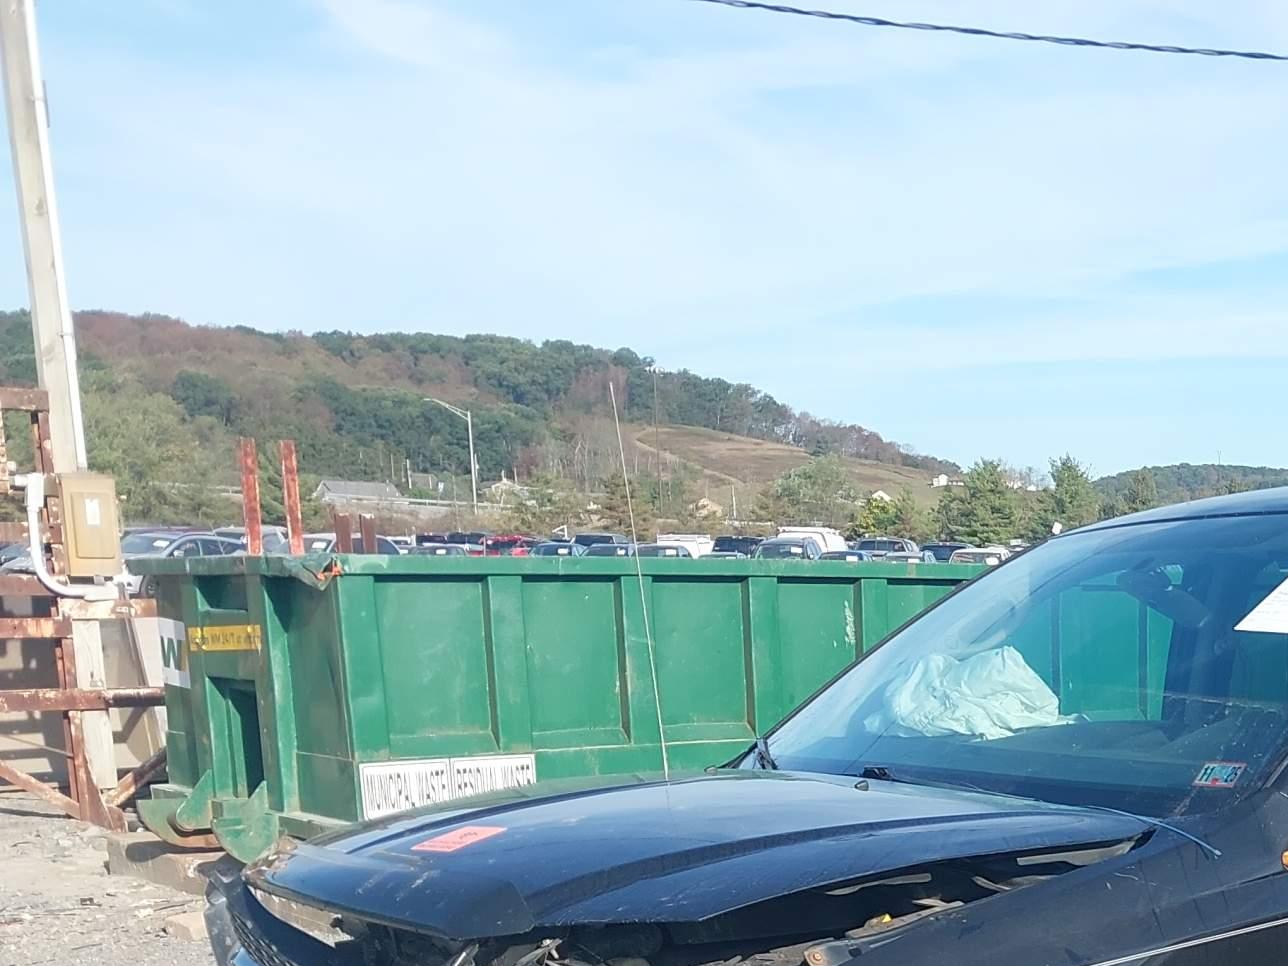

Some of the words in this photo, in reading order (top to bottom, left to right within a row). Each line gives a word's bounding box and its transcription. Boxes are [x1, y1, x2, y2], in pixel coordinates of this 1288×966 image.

[366, 772, 415, 811] MUNICIPAL
[417, 769, 446, 806] WASTE
[455, 766, 498, 796] RESIDUAL
[501, 764, 531, 789] WASTE
